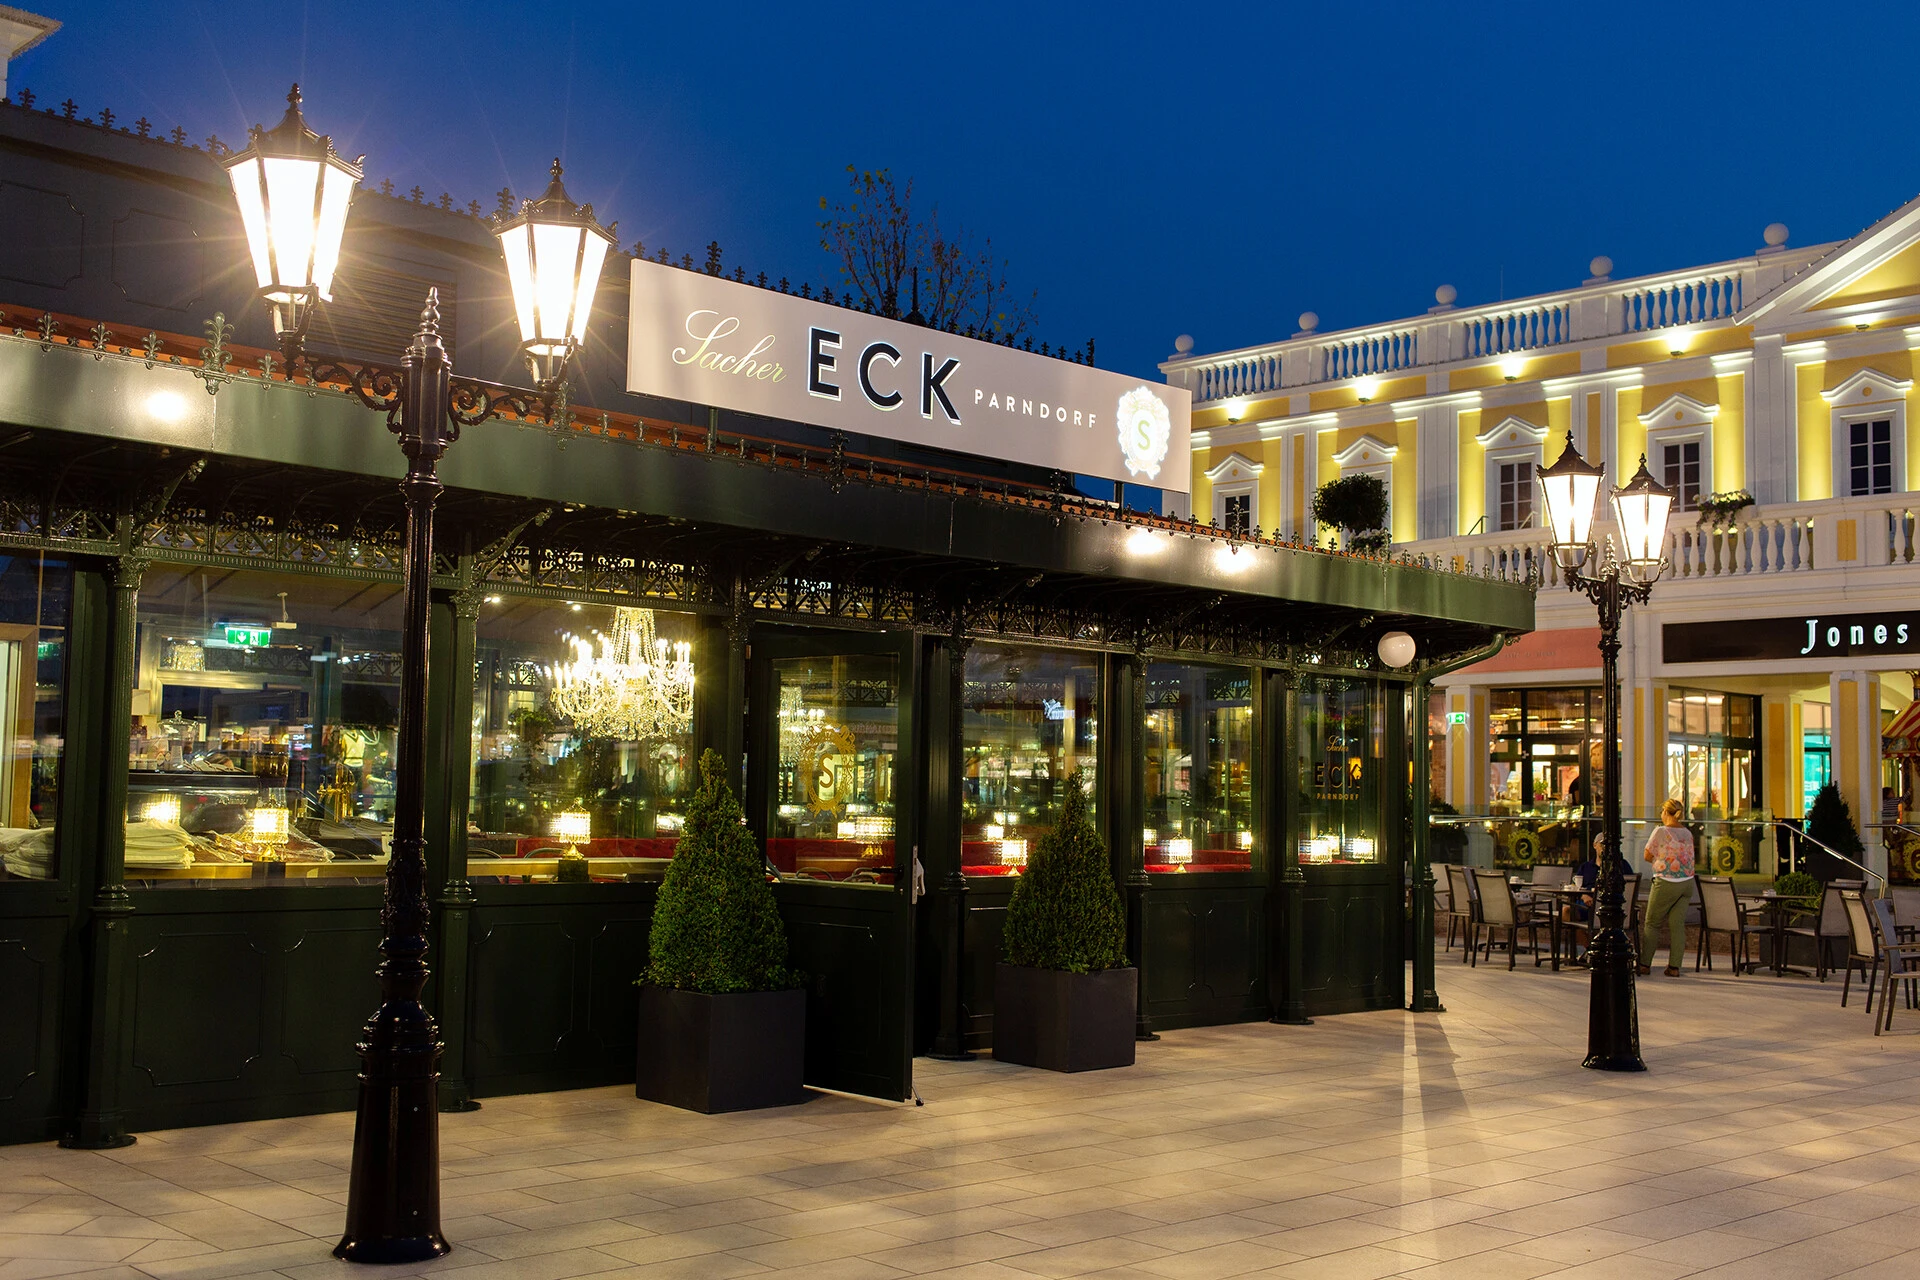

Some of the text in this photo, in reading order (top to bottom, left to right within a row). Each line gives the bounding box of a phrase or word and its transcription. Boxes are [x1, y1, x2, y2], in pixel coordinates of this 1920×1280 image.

[672, 310, 1097, 428] Sacher ECK PARNDORF
[1136, 419, 1151, 451] S
[1801, 619, 1908, 655] Jones
[819, 752, 834, 789] S
[1315, 762, 1361, 789] ECK
[1316, 792, 1359, 801] PARNDORF
